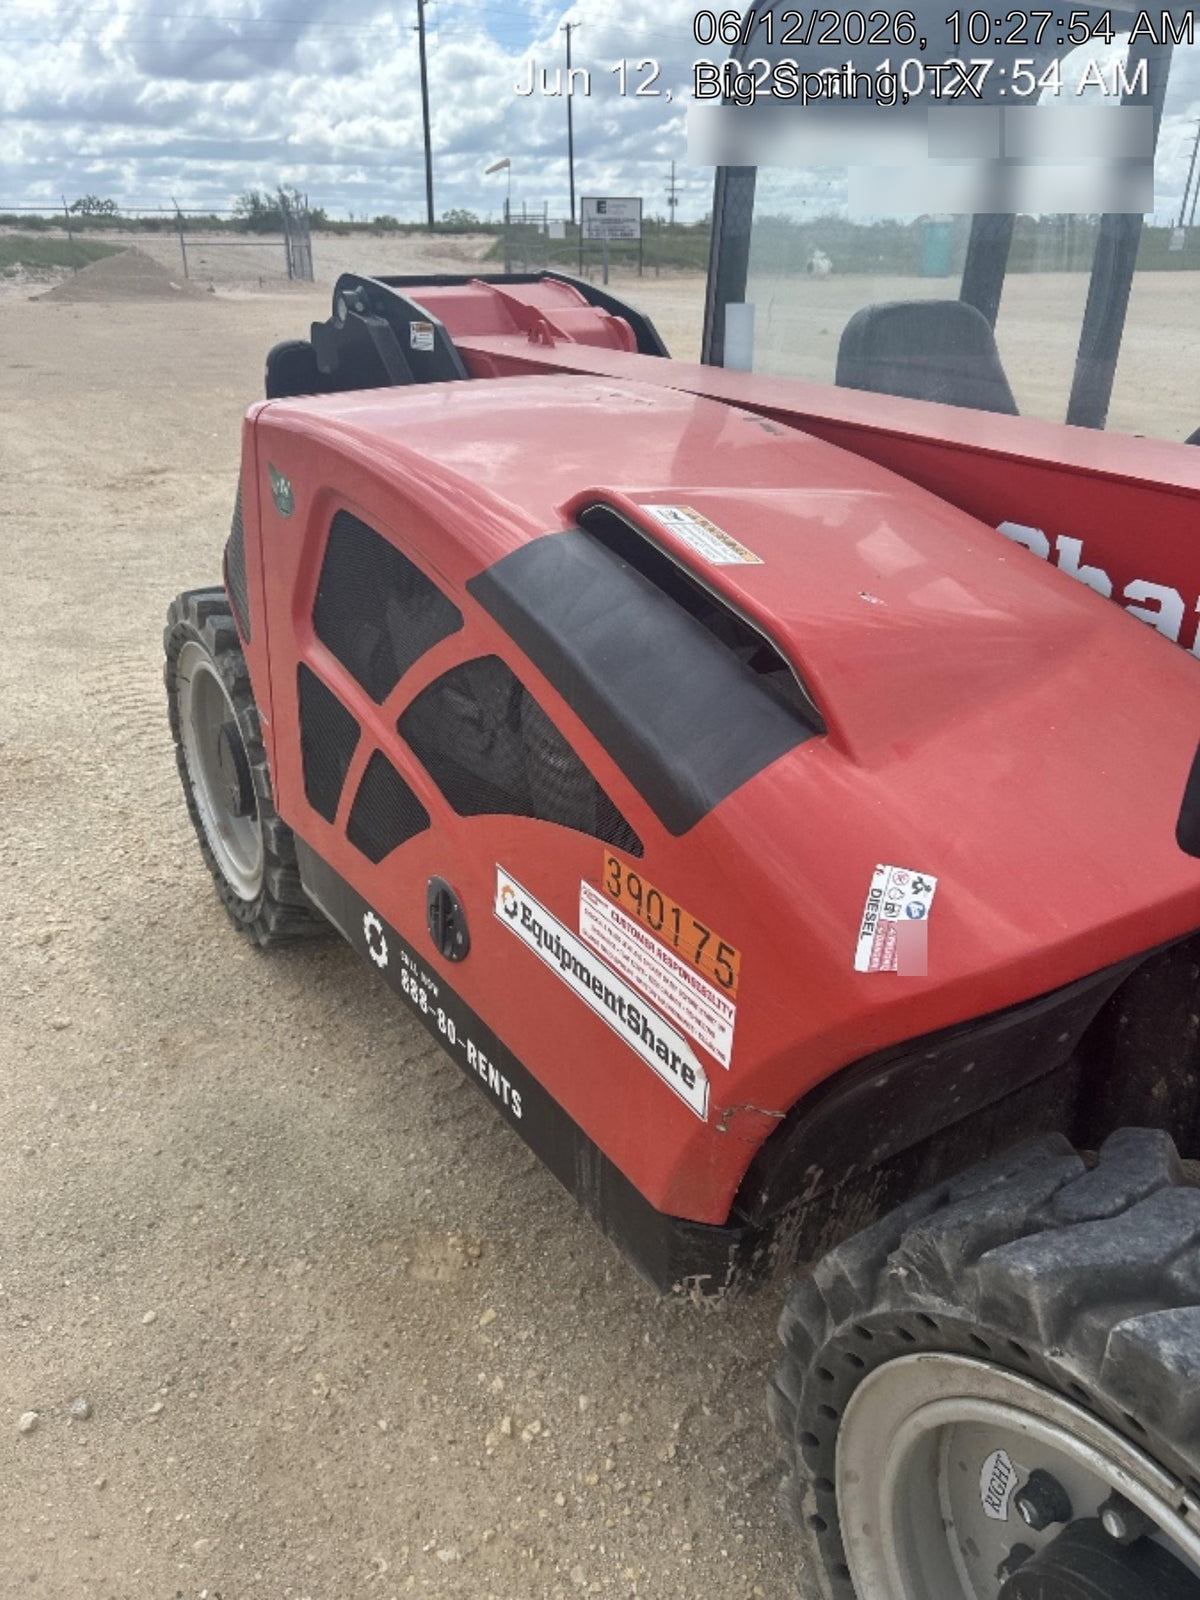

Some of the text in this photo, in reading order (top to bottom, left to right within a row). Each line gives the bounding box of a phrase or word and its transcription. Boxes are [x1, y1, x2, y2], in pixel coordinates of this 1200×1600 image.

[606, 857, 736, 989] 390175
[610, 908, 656, 955] CUSTOMER
[861, 888, 882, 941] DIESEL
[401, 968, 522, 1119] 888-80-RENTS
[520, 901, 696, 1090] EquipmentShare
[984, 1453, 1011, 1514] RIGHT
